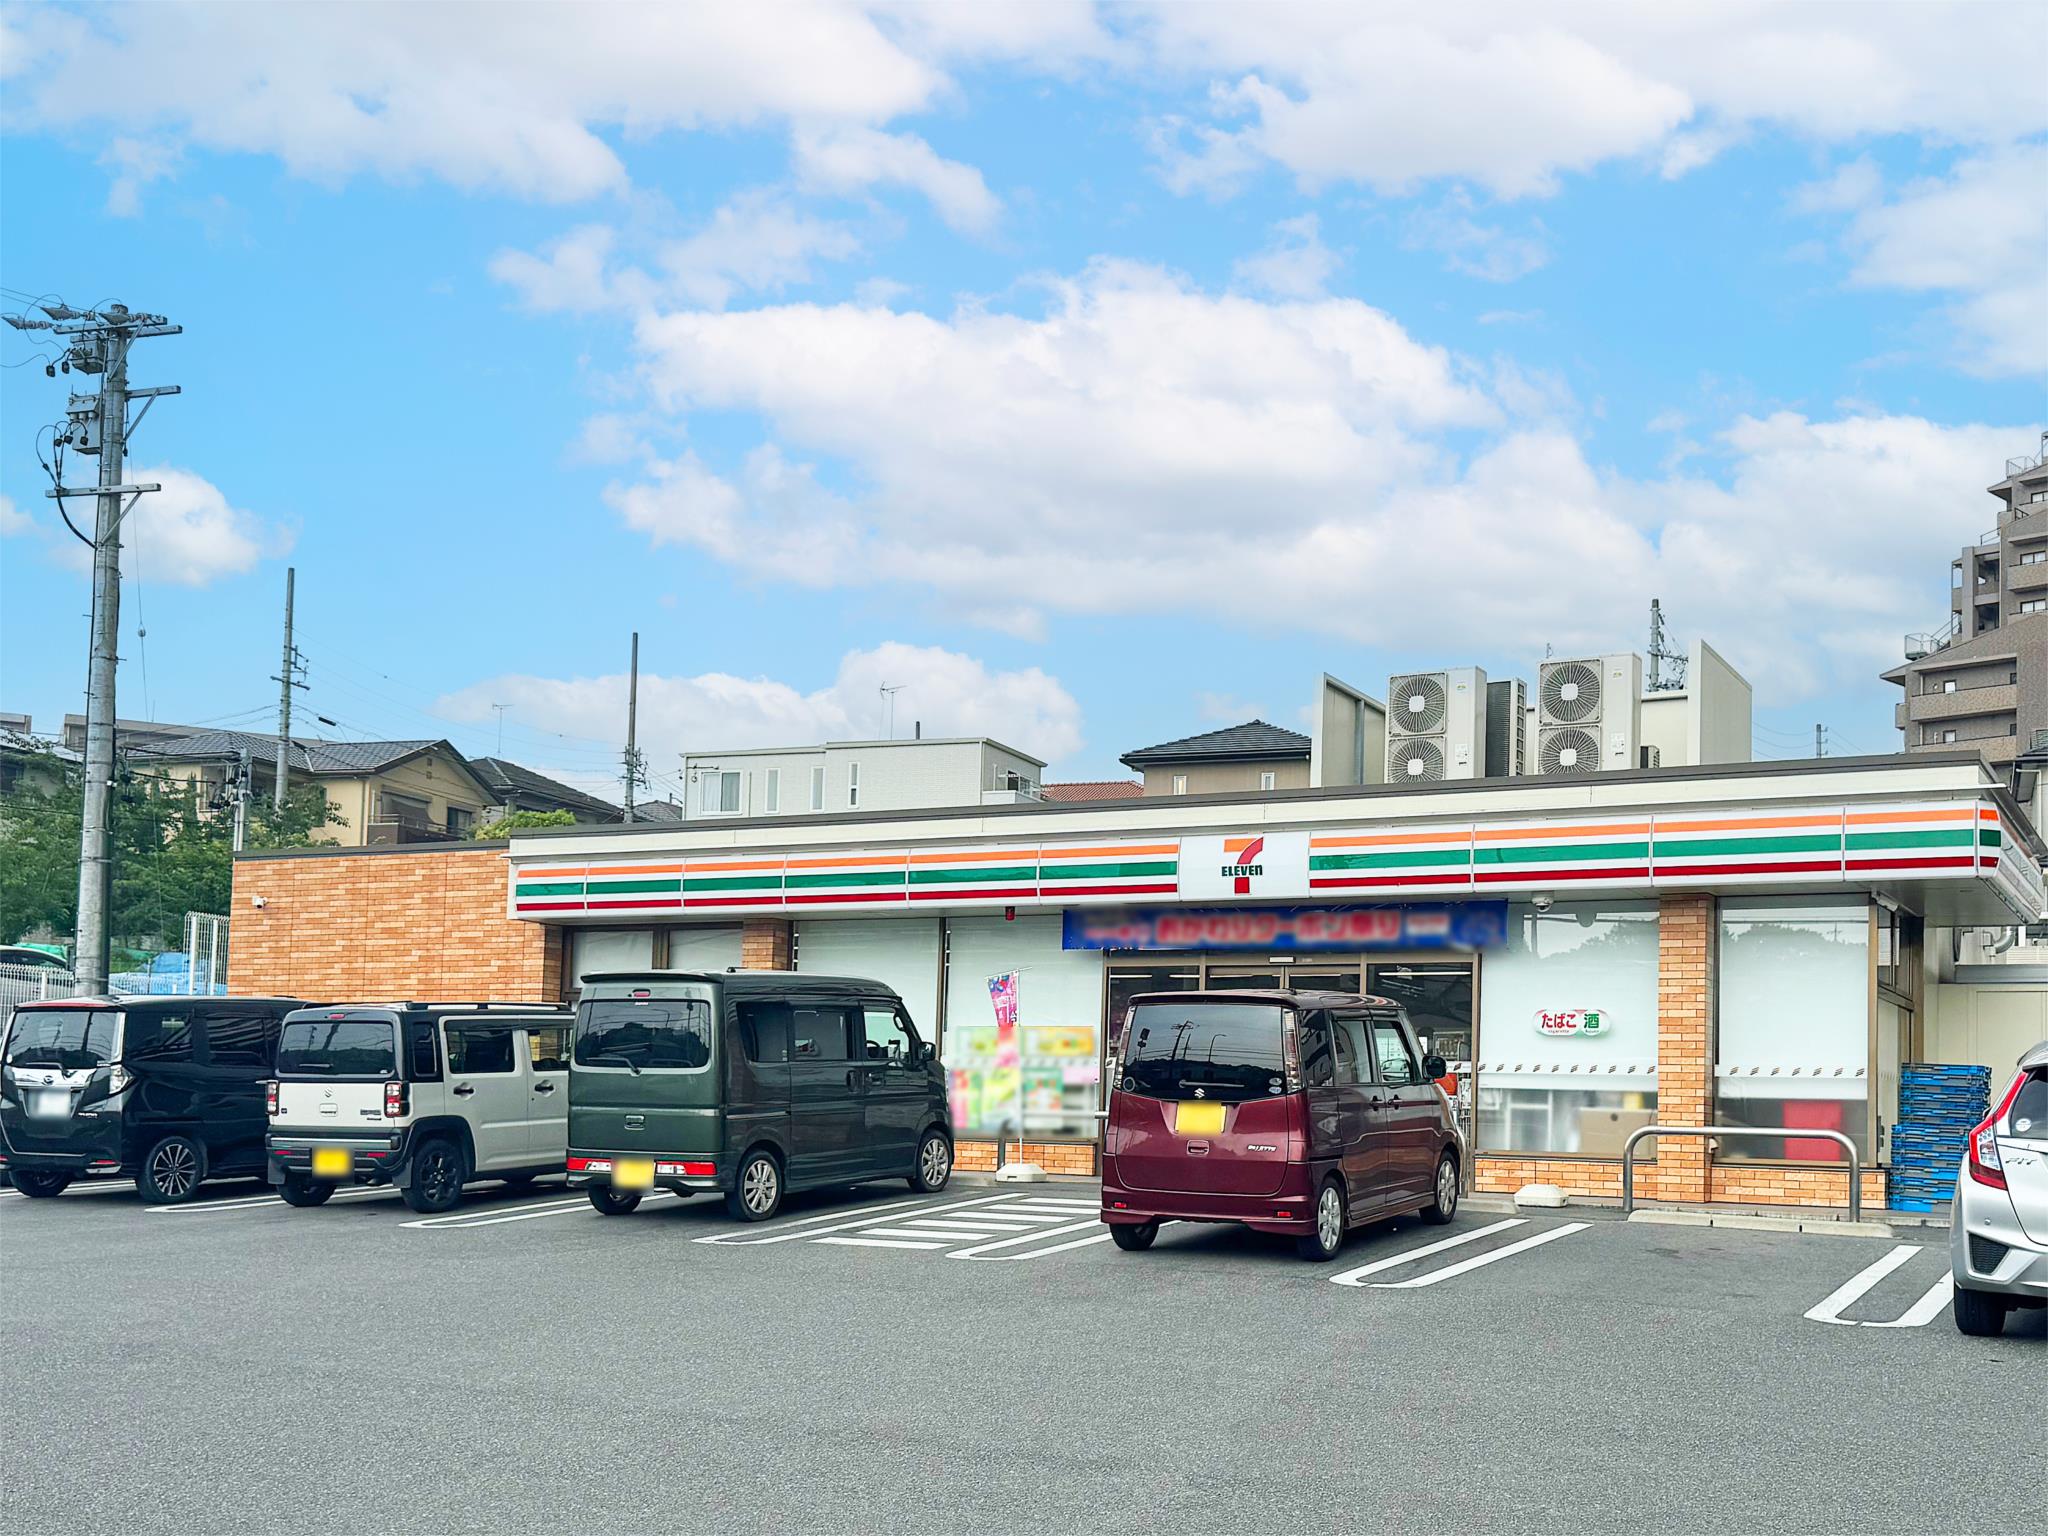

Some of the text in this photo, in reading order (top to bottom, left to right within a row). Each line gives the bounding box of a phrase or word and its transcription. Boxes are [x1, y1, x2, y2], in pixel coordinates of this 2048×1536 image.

[1223, 836, 1264, 894] 7
[1541, 1013, 1600, 1029] たばこ 酒
